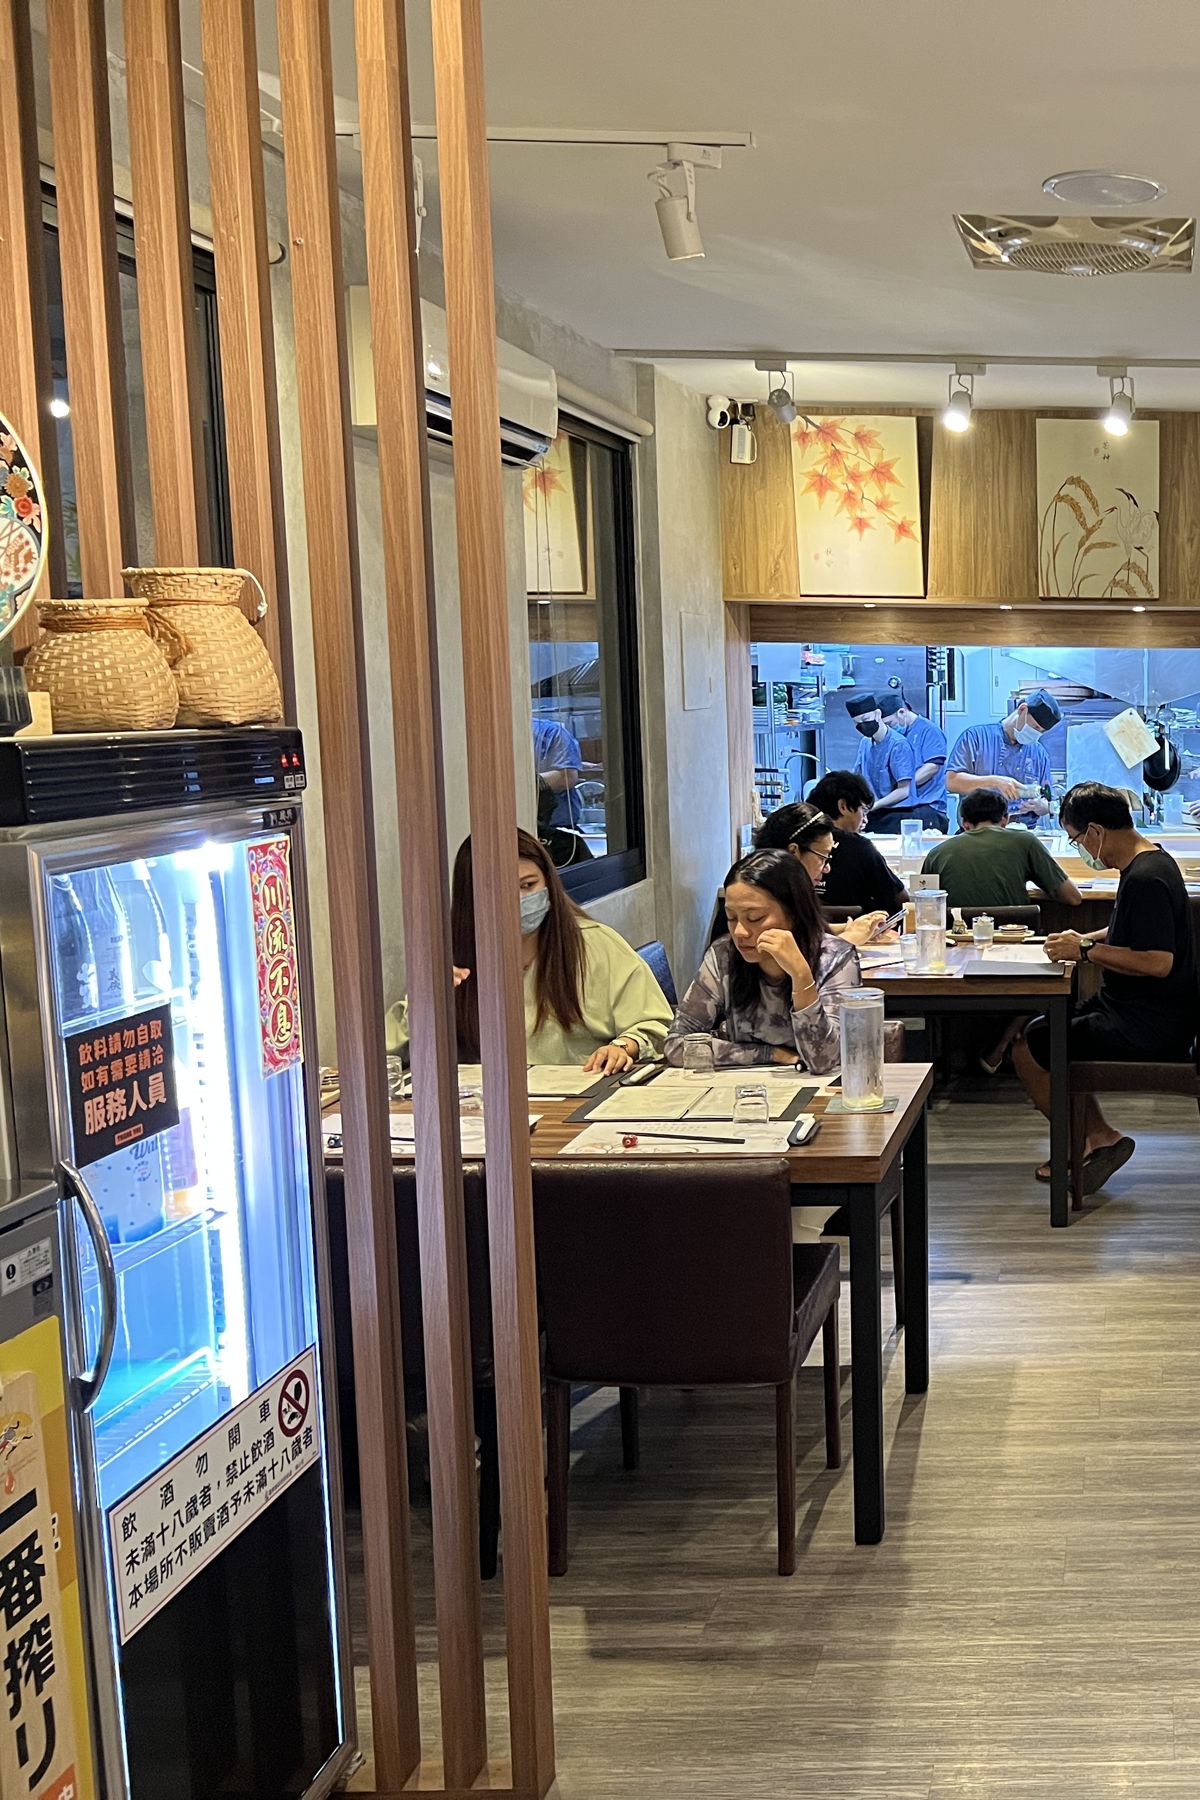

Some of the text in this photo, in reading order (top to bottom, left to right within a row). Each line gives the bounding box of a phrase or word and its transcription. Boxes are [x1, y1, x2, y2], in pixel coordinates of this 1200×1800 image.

[262, 875, 292, 1044] 川流不息
[78, 1019, 163, 1066] 飲料請勿自取
[80, 1044, 165, 1094] 如有需要請洽
[83, 1071, 167, 1135] 服務人員
[128, 1425, 314, 1609] 本場所不販賣酒予未滿十八歲者
[0, 1487, 56, 1792] 一番搾り
